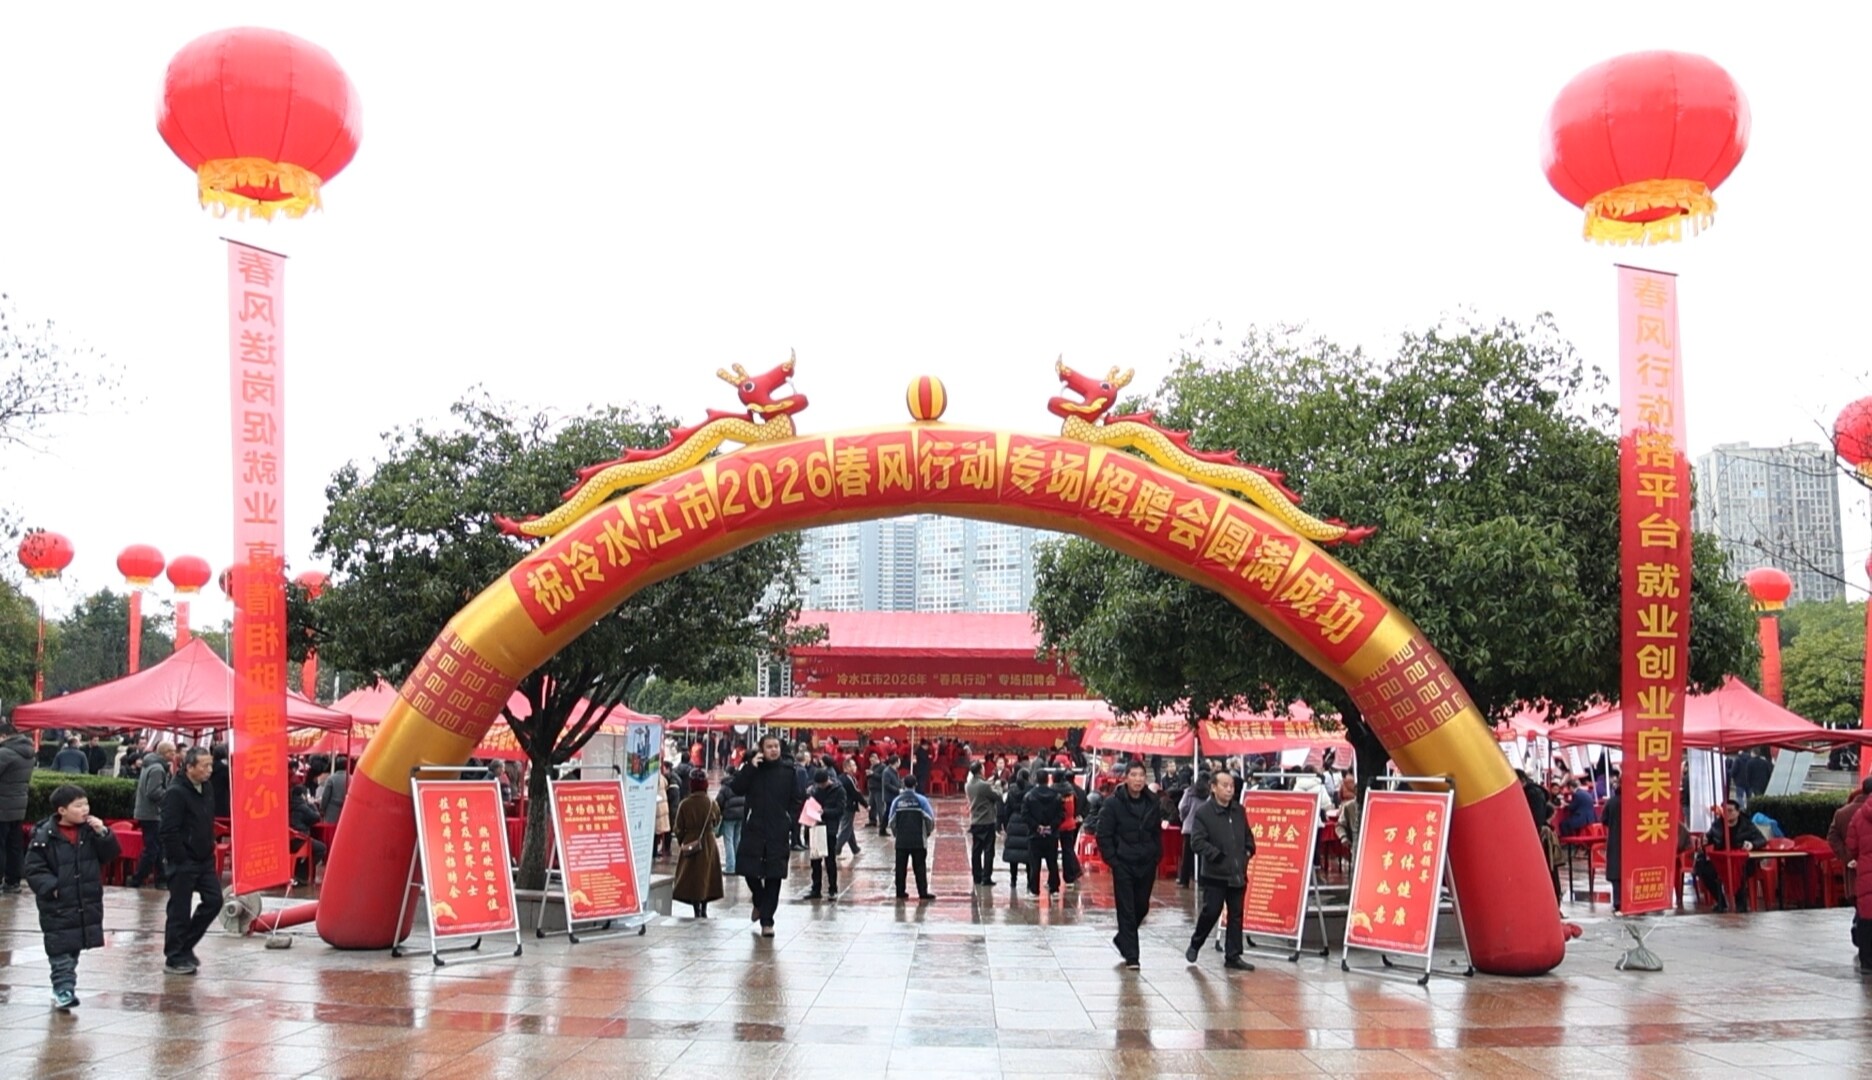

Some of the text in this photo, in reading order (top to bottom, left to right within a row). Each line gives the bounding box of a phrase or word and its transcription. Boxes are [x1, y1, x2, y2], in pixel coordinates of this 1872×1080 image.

[1372, 827, 1398, 924] 万事如意
[1391, 826, 1418, 926] 身体健康
